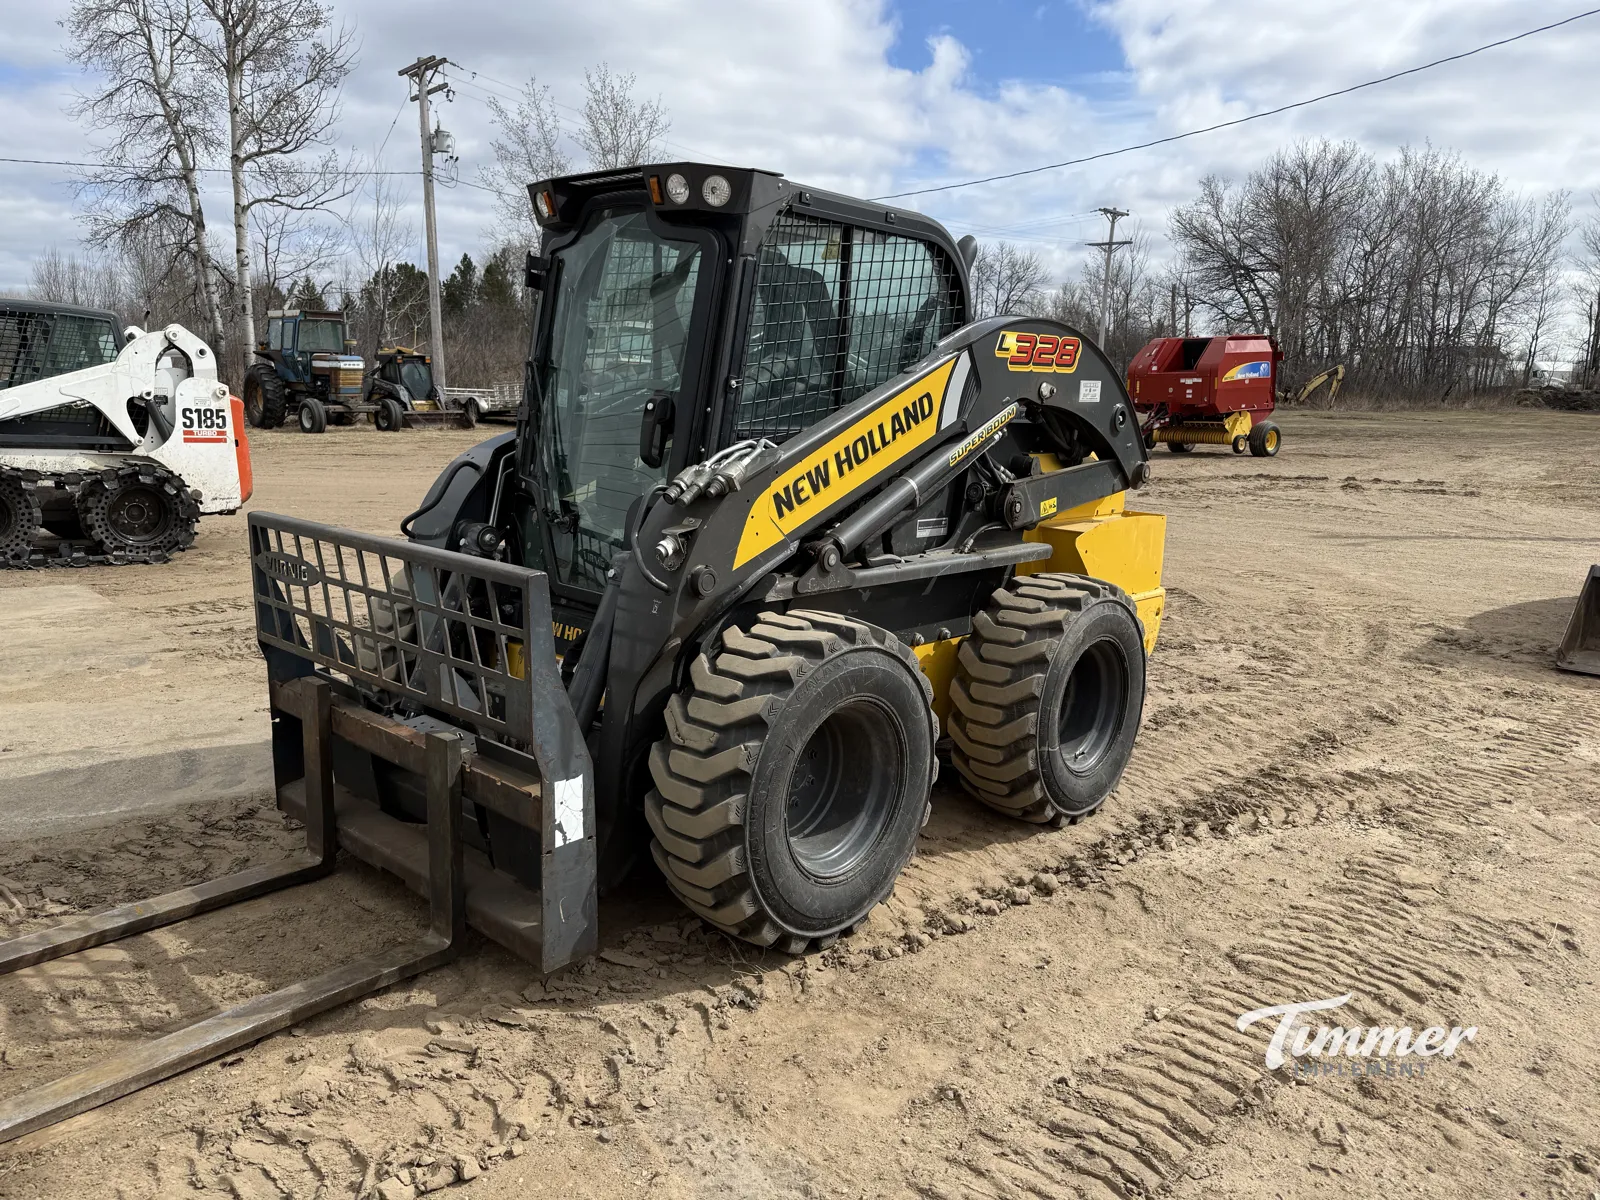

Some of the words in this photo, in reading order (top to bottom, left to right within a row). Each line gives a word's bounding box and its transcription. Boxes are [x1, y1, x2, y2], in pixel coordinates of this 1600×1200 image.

[182, 407, 227, 429] S185
[772, 458, 831, 520] NEW
[833, 391, 934, 480] HOLLAND
